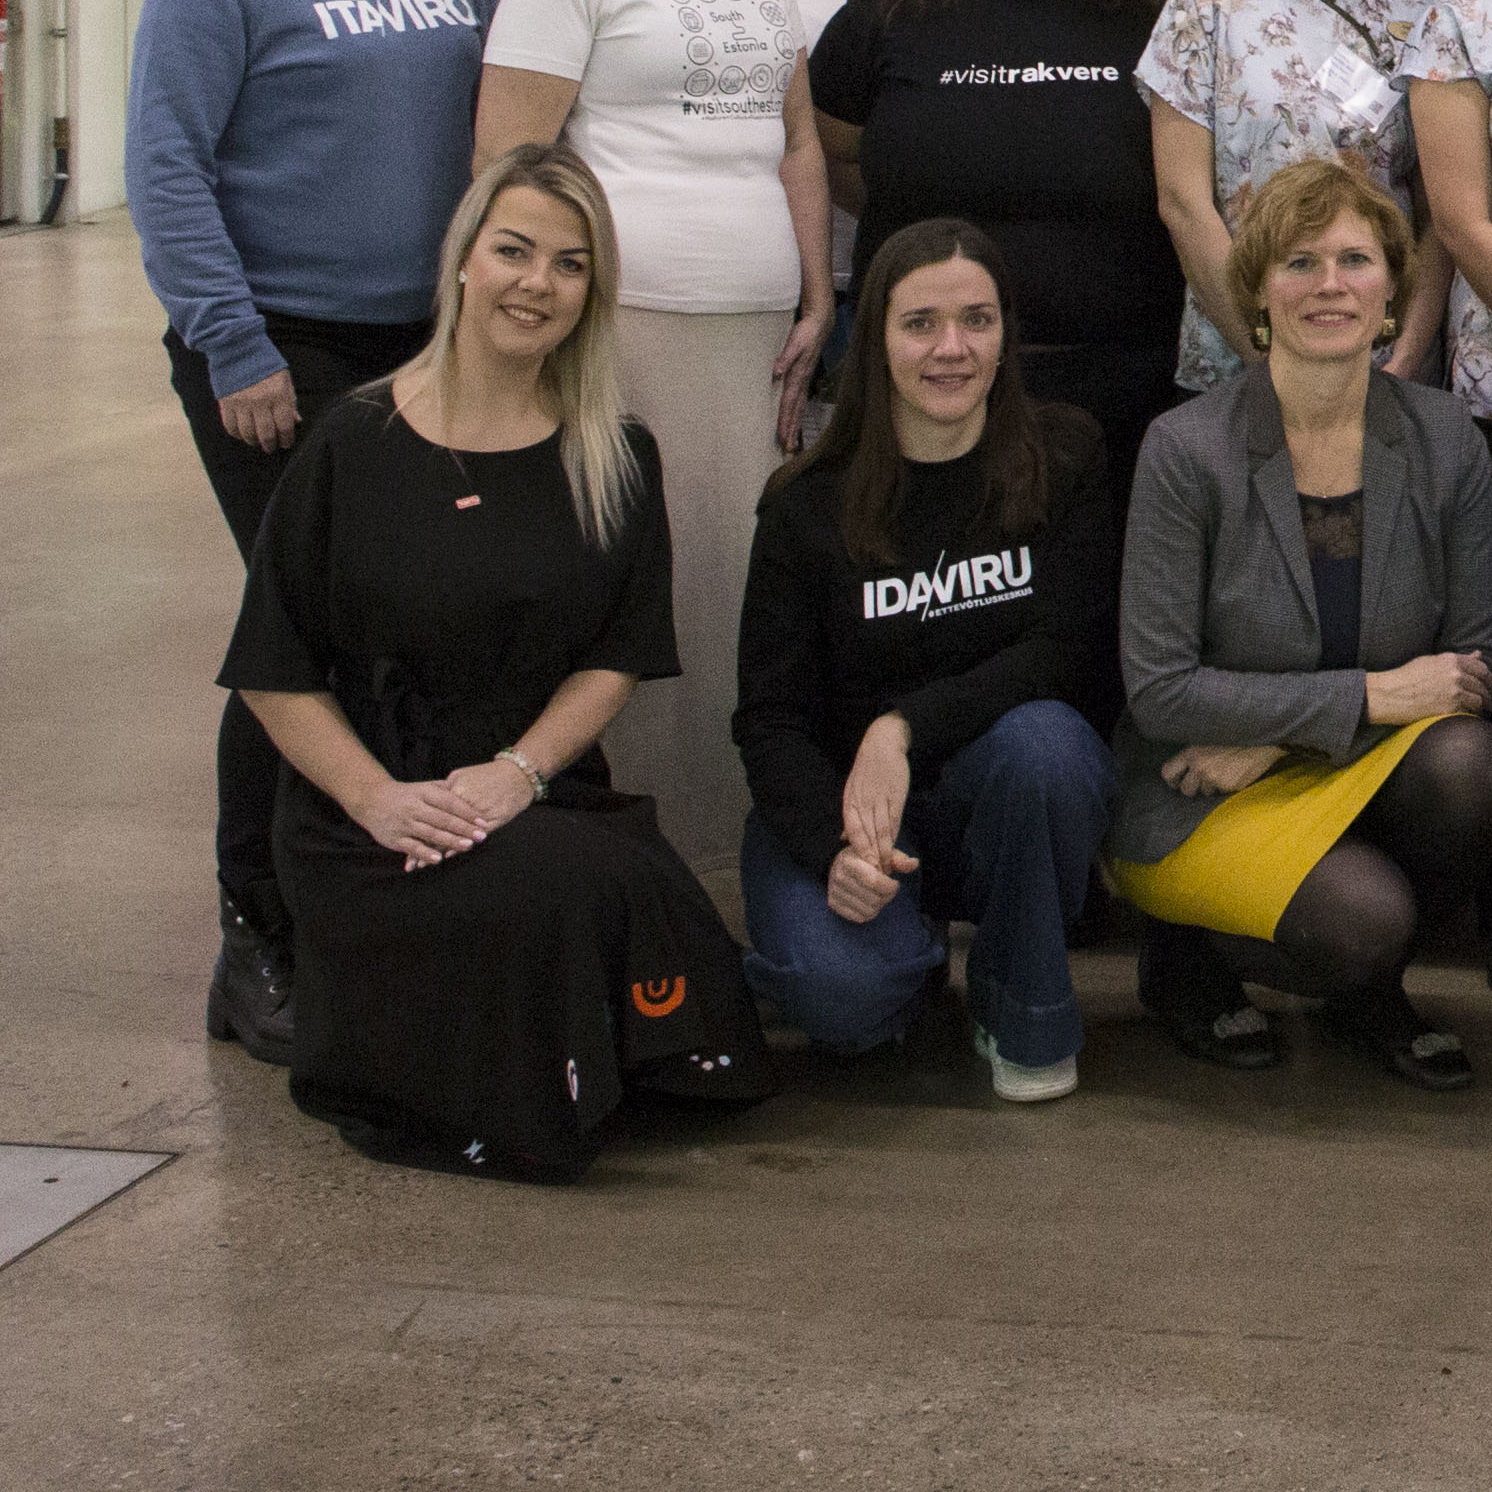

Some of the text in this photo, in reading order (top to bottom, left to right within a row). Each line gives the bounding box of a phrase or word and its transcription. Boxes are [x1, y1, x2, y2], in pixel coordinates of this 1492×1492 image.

[710, 11, 745, 23] South
[723, 41, 769, 54] Estonia
[939, 62, 1120, 85] #visitrakvere
[863, 546, 1033, 622] IDAVIRU
